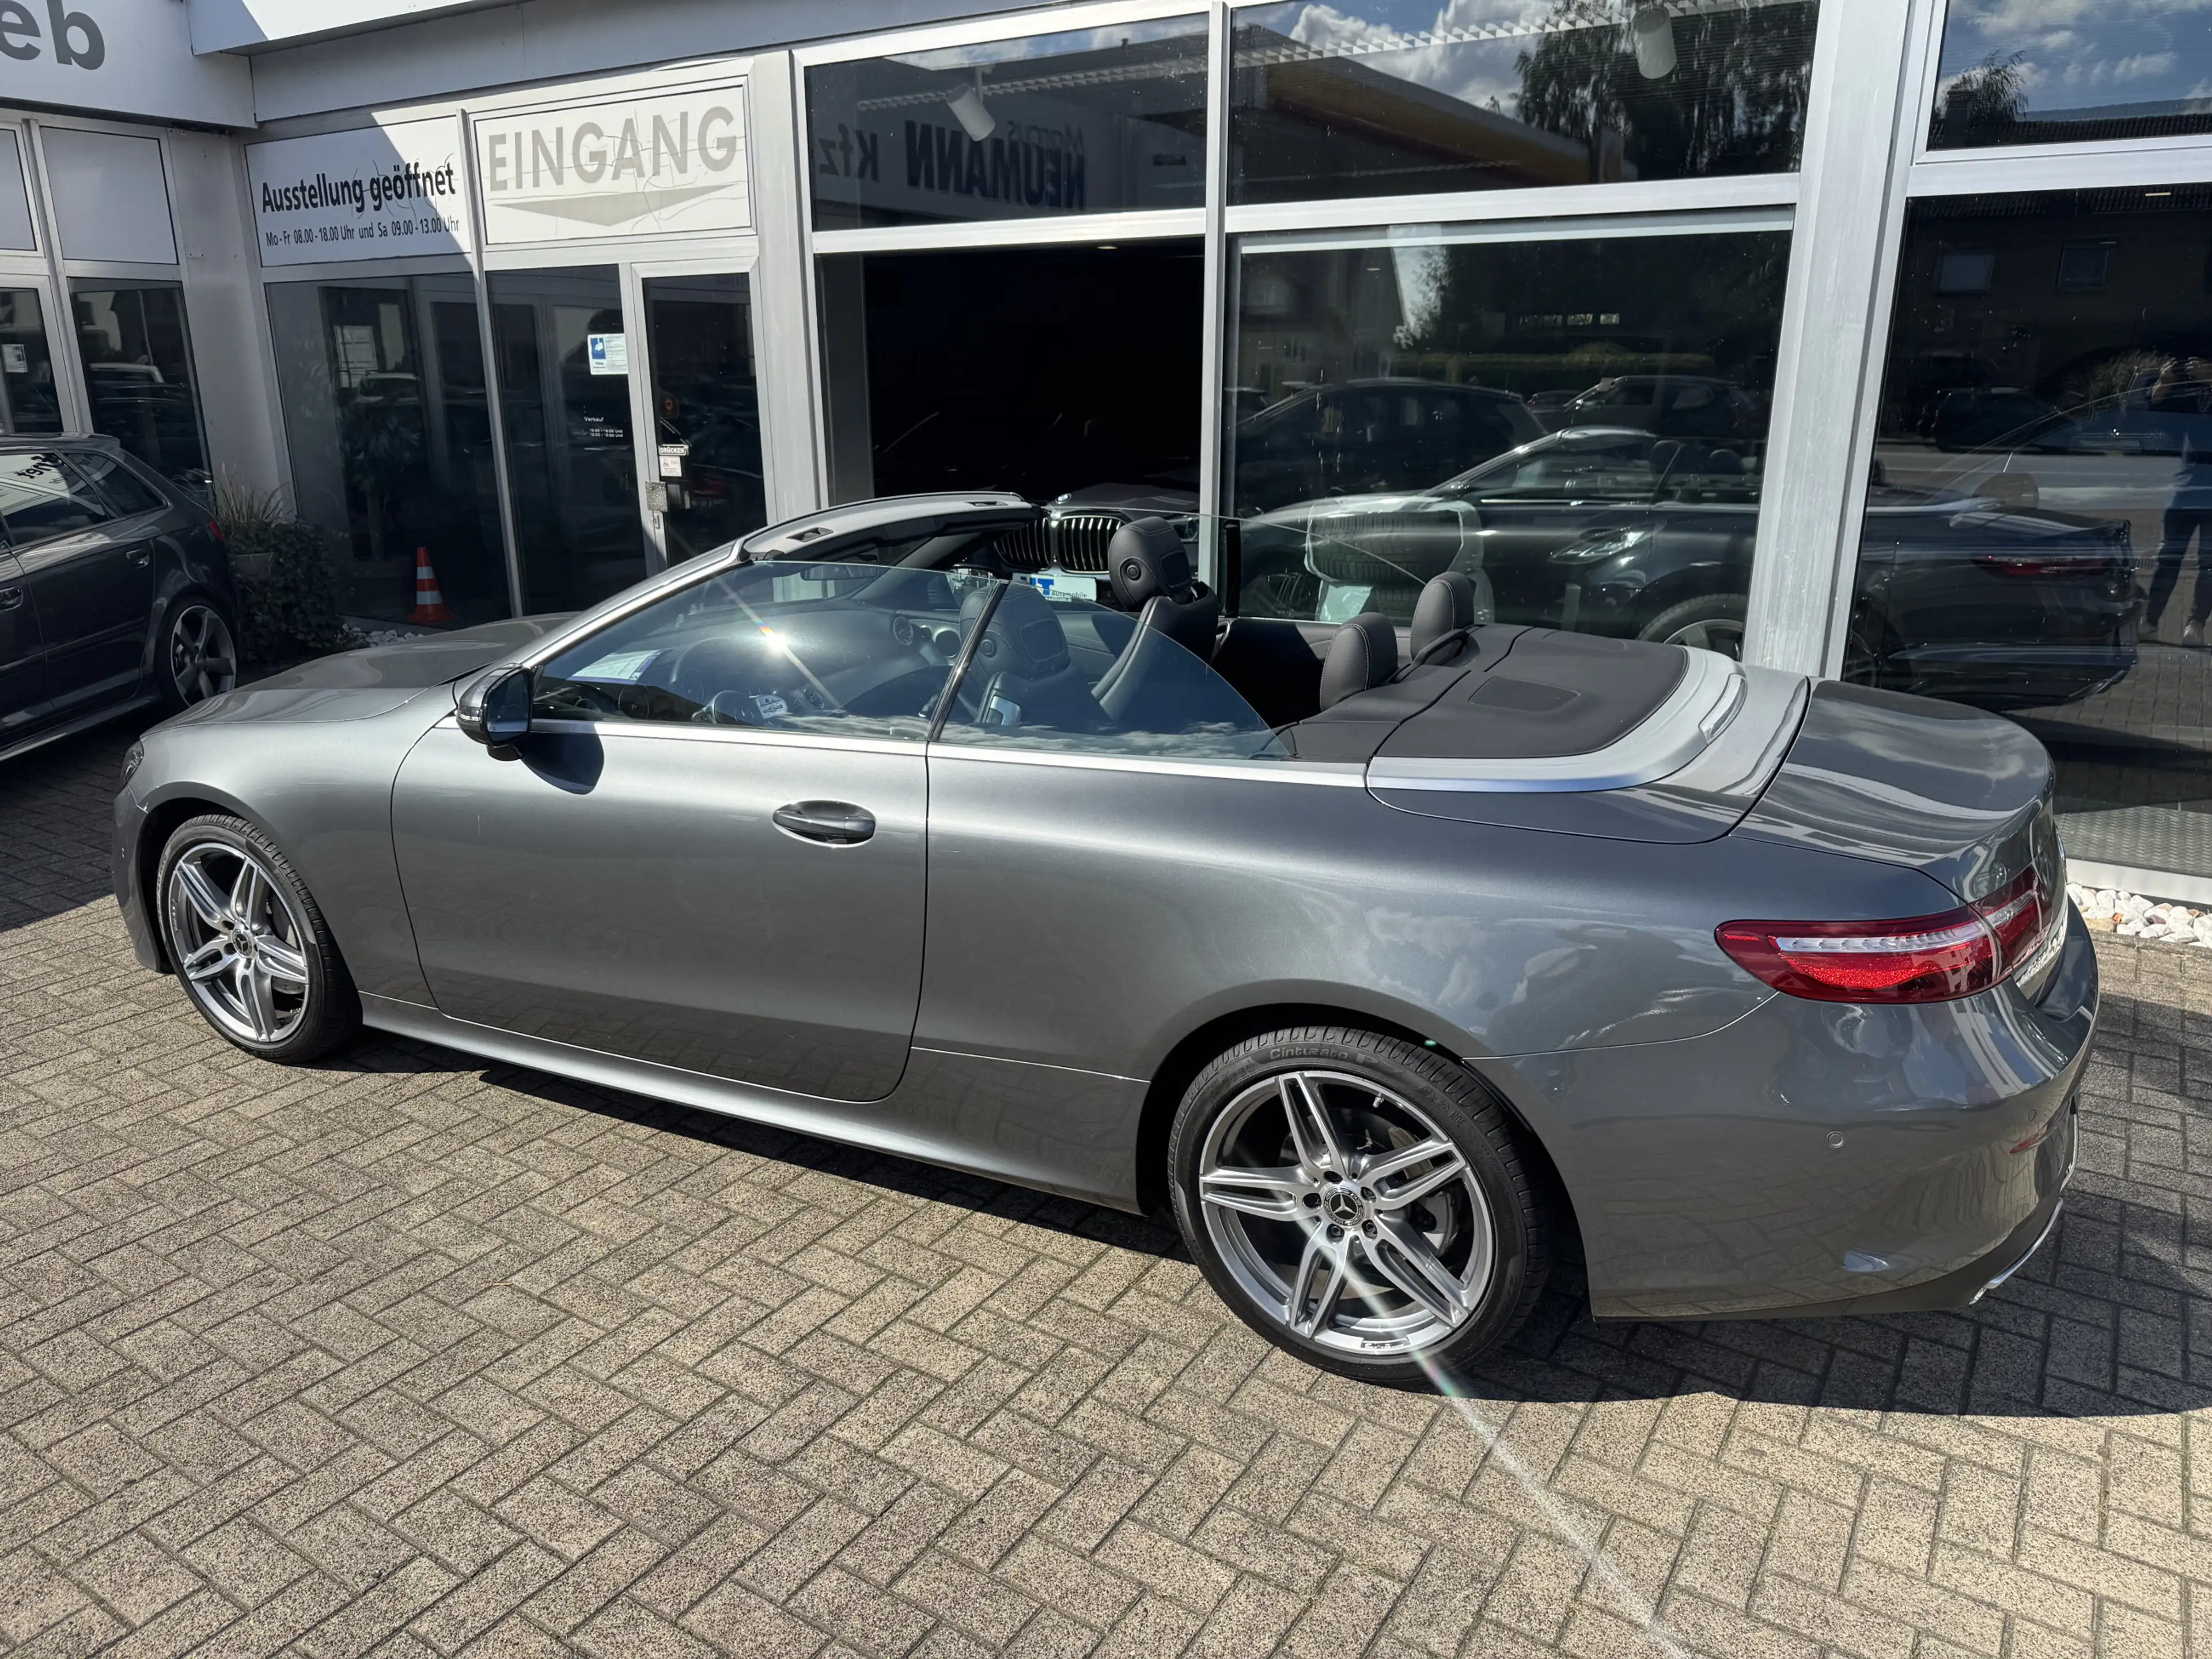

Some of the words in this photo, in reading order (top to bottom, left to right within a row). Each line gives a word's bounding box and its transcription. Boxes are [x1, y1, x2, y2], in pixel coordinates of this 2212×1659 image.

[488, 106, 737, 192] EINGANG
[262, 173, 364, 213] Ausstellung
[370, 162, 456, 211] geöffnet
[266, 232, 278, 246] Mo
[283, 231, 290, 245] Fr
[294, 228, 313, 244] 08.00
[319, 226, 339, 241] 18.00
[340, 224, 354, 240] Uhr
[359, 222, 374, 239] und
[378, 222, 388, 237] Sa
[391, 219, 414, 236] 09.00
[420, 218, 441, 234] 13.00
[444, 215, 459, 232] Uhr
[1269, 1046, 1349, 1060] Cinturato
